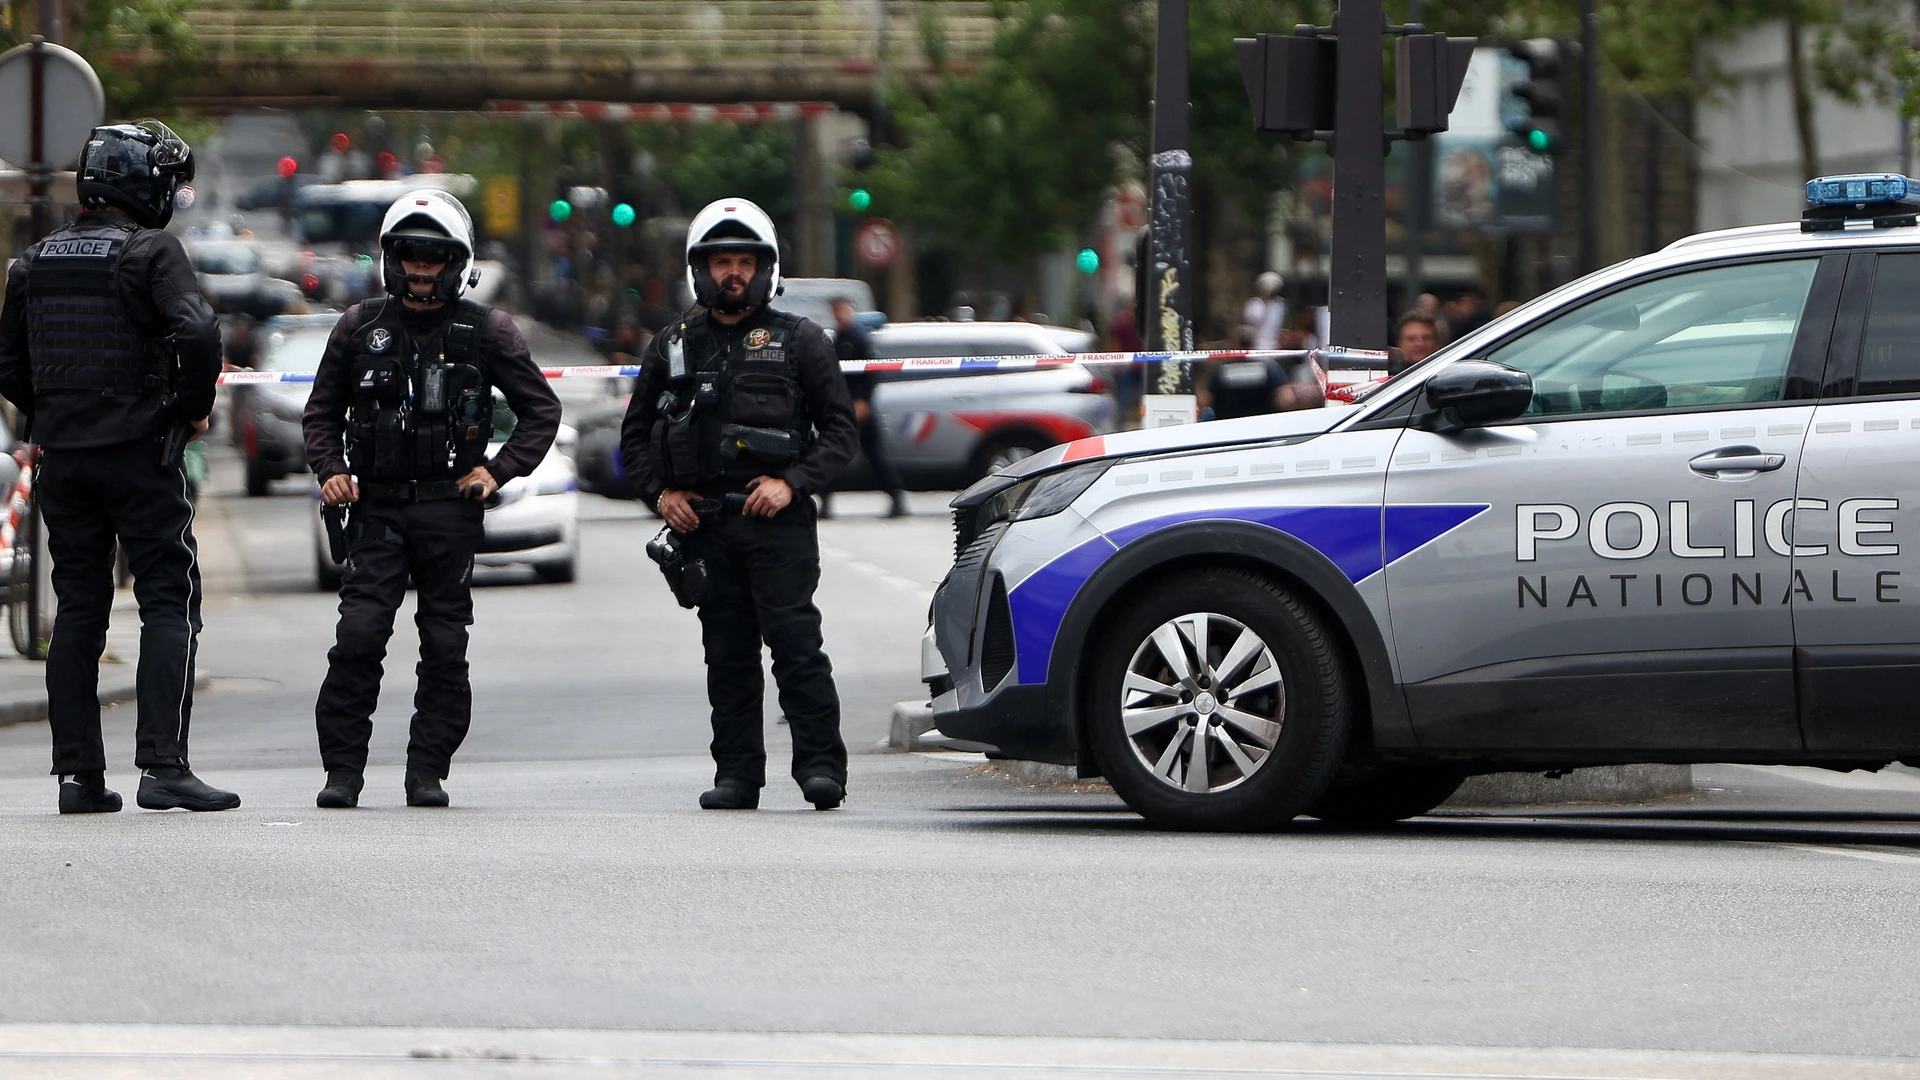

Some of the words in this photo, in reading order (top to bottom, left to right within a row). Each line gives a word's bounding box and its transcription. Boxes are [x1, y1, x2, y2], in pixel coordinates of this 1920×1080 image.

[46, 242, 104, 255] POLICE
[746, 350, 785, 360] POLICE
[1082, 353, 1125, 361] FRANCHIR
[1515, 498, 1900, 562] POLICE
[1517, 569, 1900, 608] NATIONALE
